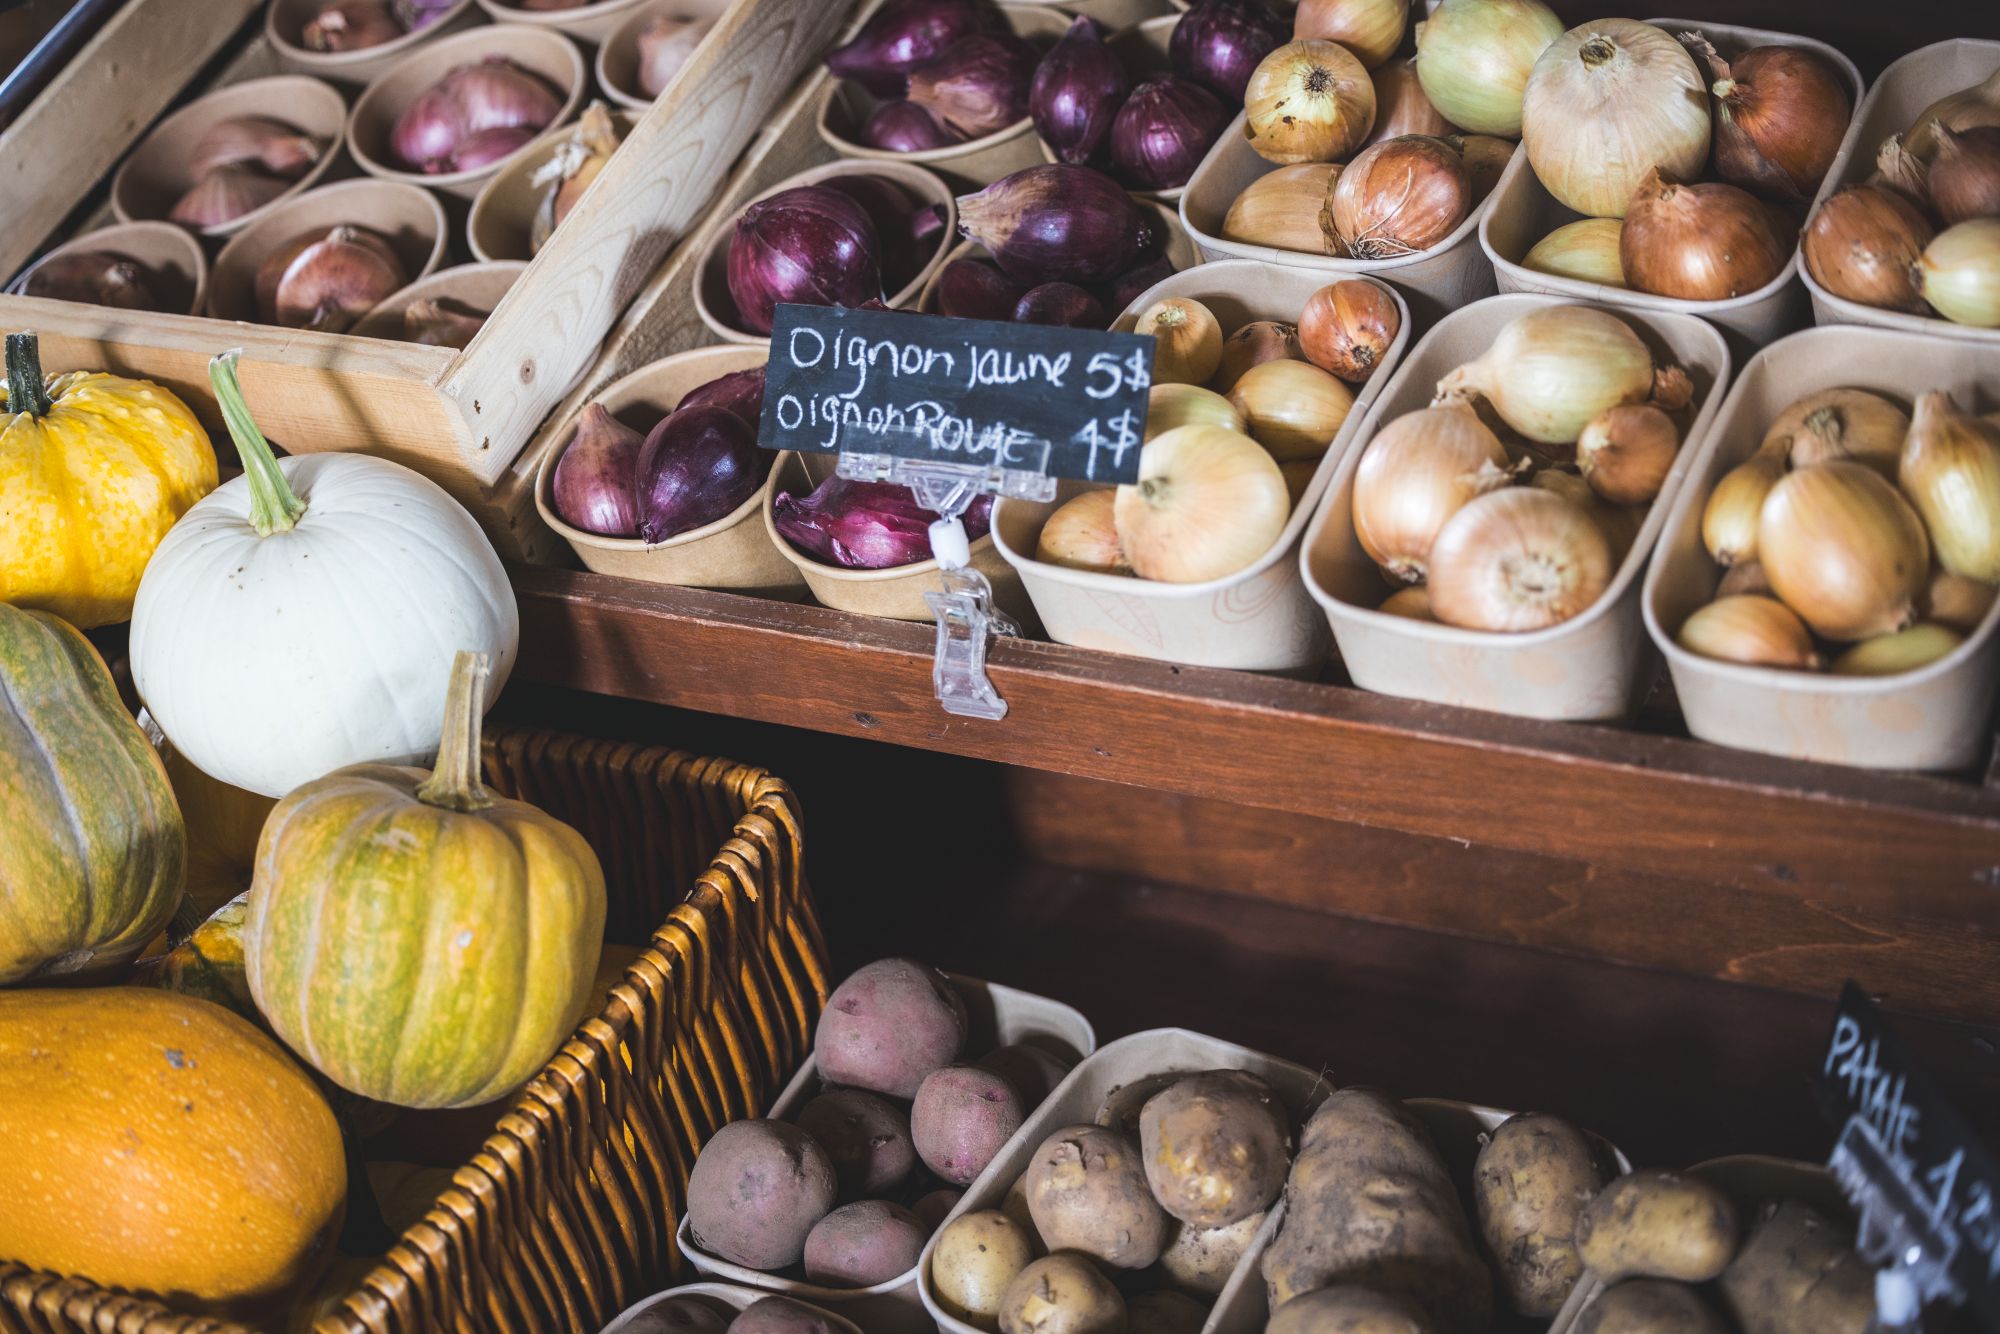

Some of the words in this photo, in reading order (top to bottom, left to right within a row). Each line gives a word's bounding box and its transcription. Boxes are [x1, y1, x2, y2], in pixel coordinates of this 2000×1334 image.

[789, 326, 955, 400] Oignon
[963, 340, 1073, 391] jaune
[1084, 346, 1151, 400] 5$
[776, 393, 904, 448] Oignon
